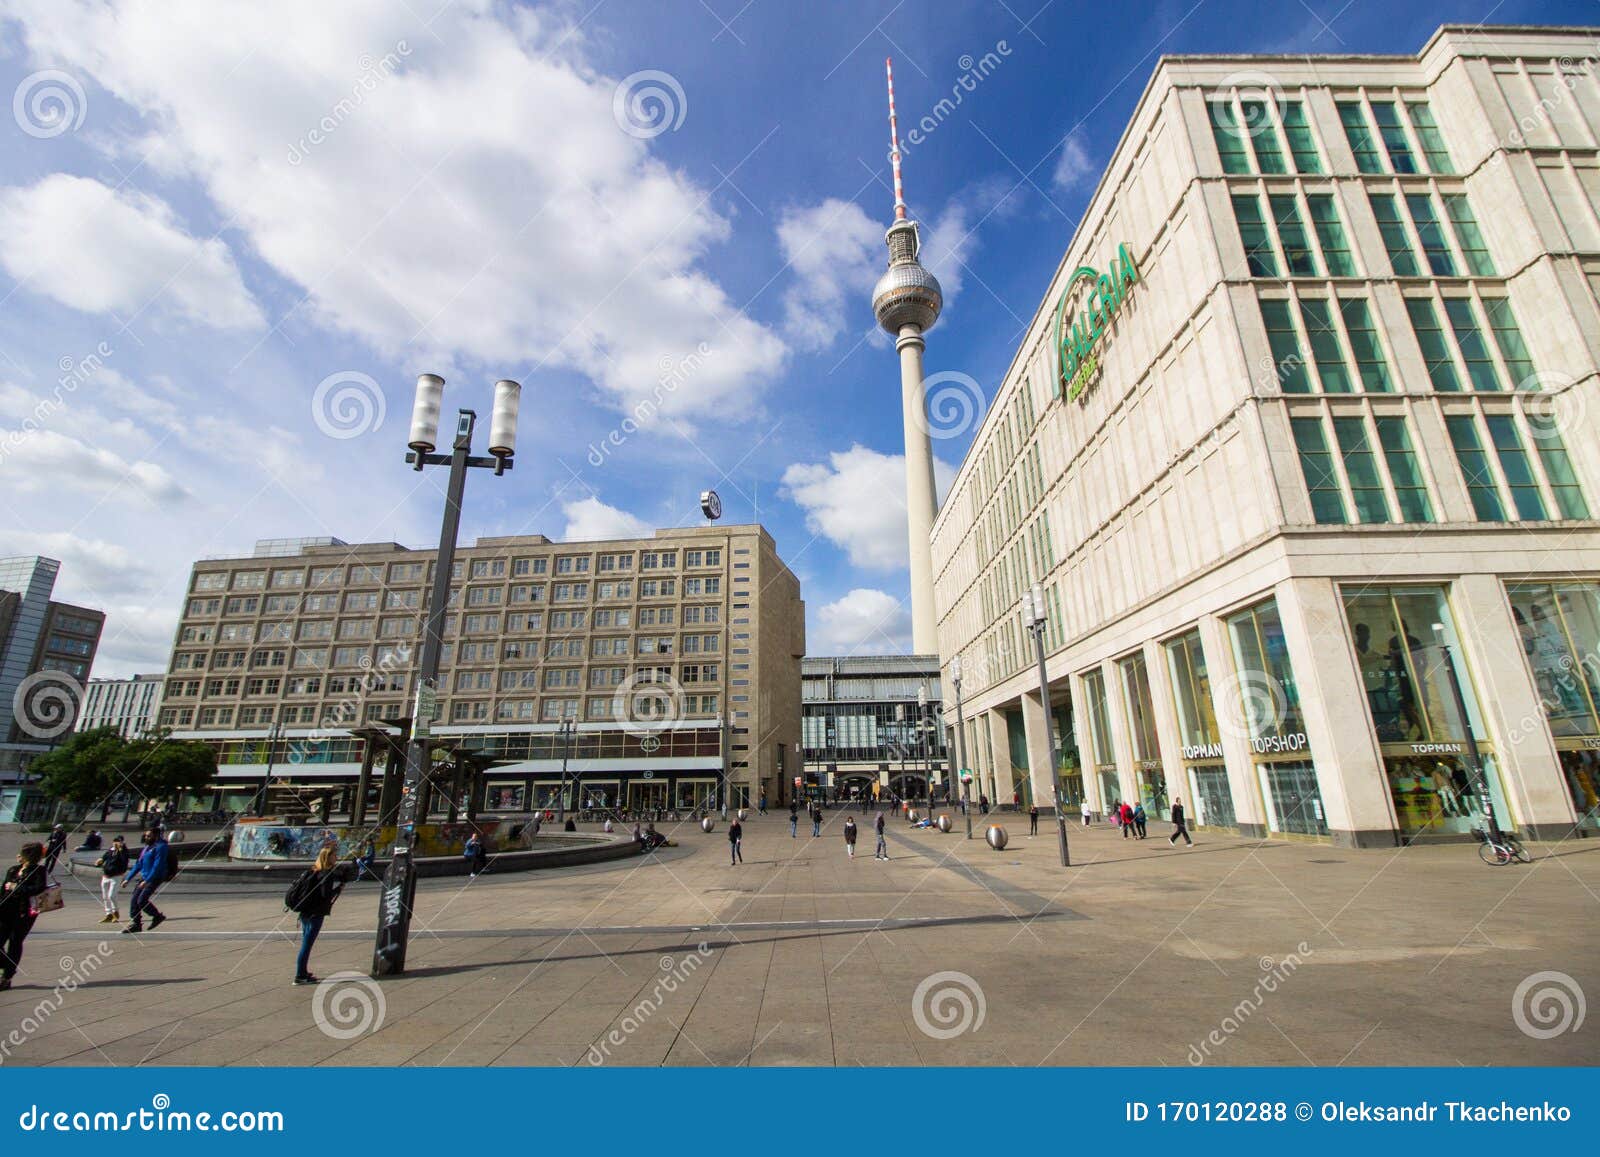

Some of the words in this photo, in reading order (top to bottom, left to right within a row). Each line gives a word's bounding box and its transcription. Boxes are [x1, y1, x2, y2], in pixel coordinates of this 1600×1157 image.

[1061, 241, 1137, 382] GALERIA
[1182, 742, 1223, 759] TOPMAN
[1249, 732, 1306, 753] TOPSHOP
[1411, 743, 1462, 754] TOPMAN
